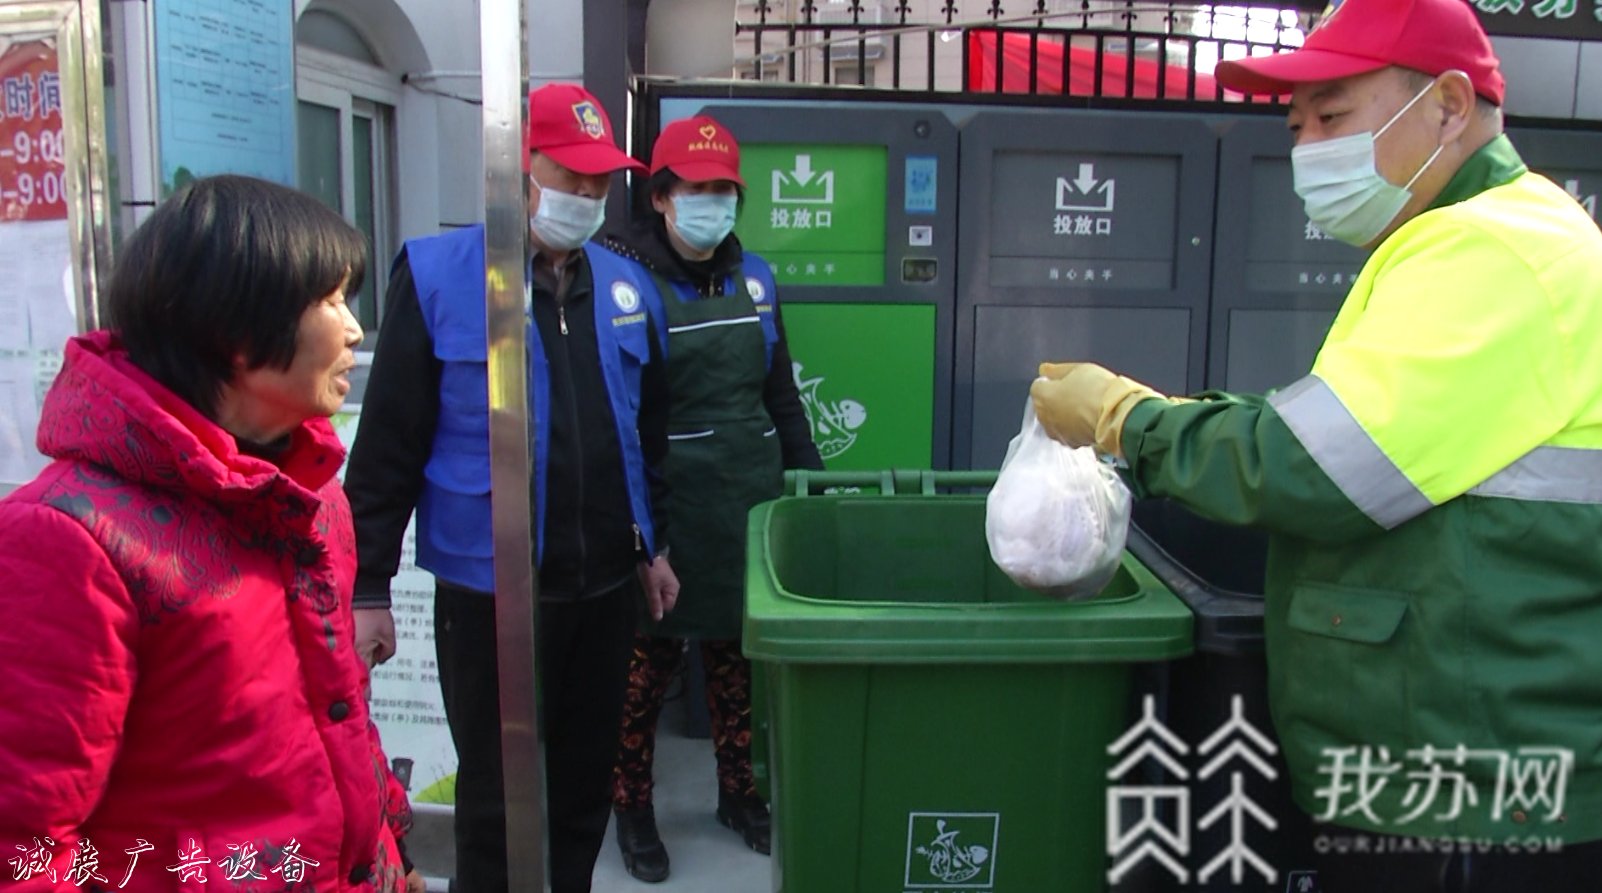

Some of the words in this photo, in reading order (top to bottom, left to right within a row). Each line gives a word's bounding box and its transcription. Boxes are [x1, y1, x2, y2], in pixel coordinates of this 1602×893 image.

[770, 208, 832, 229] 投放口
[1053, 214, 1112, 236] 投放口
